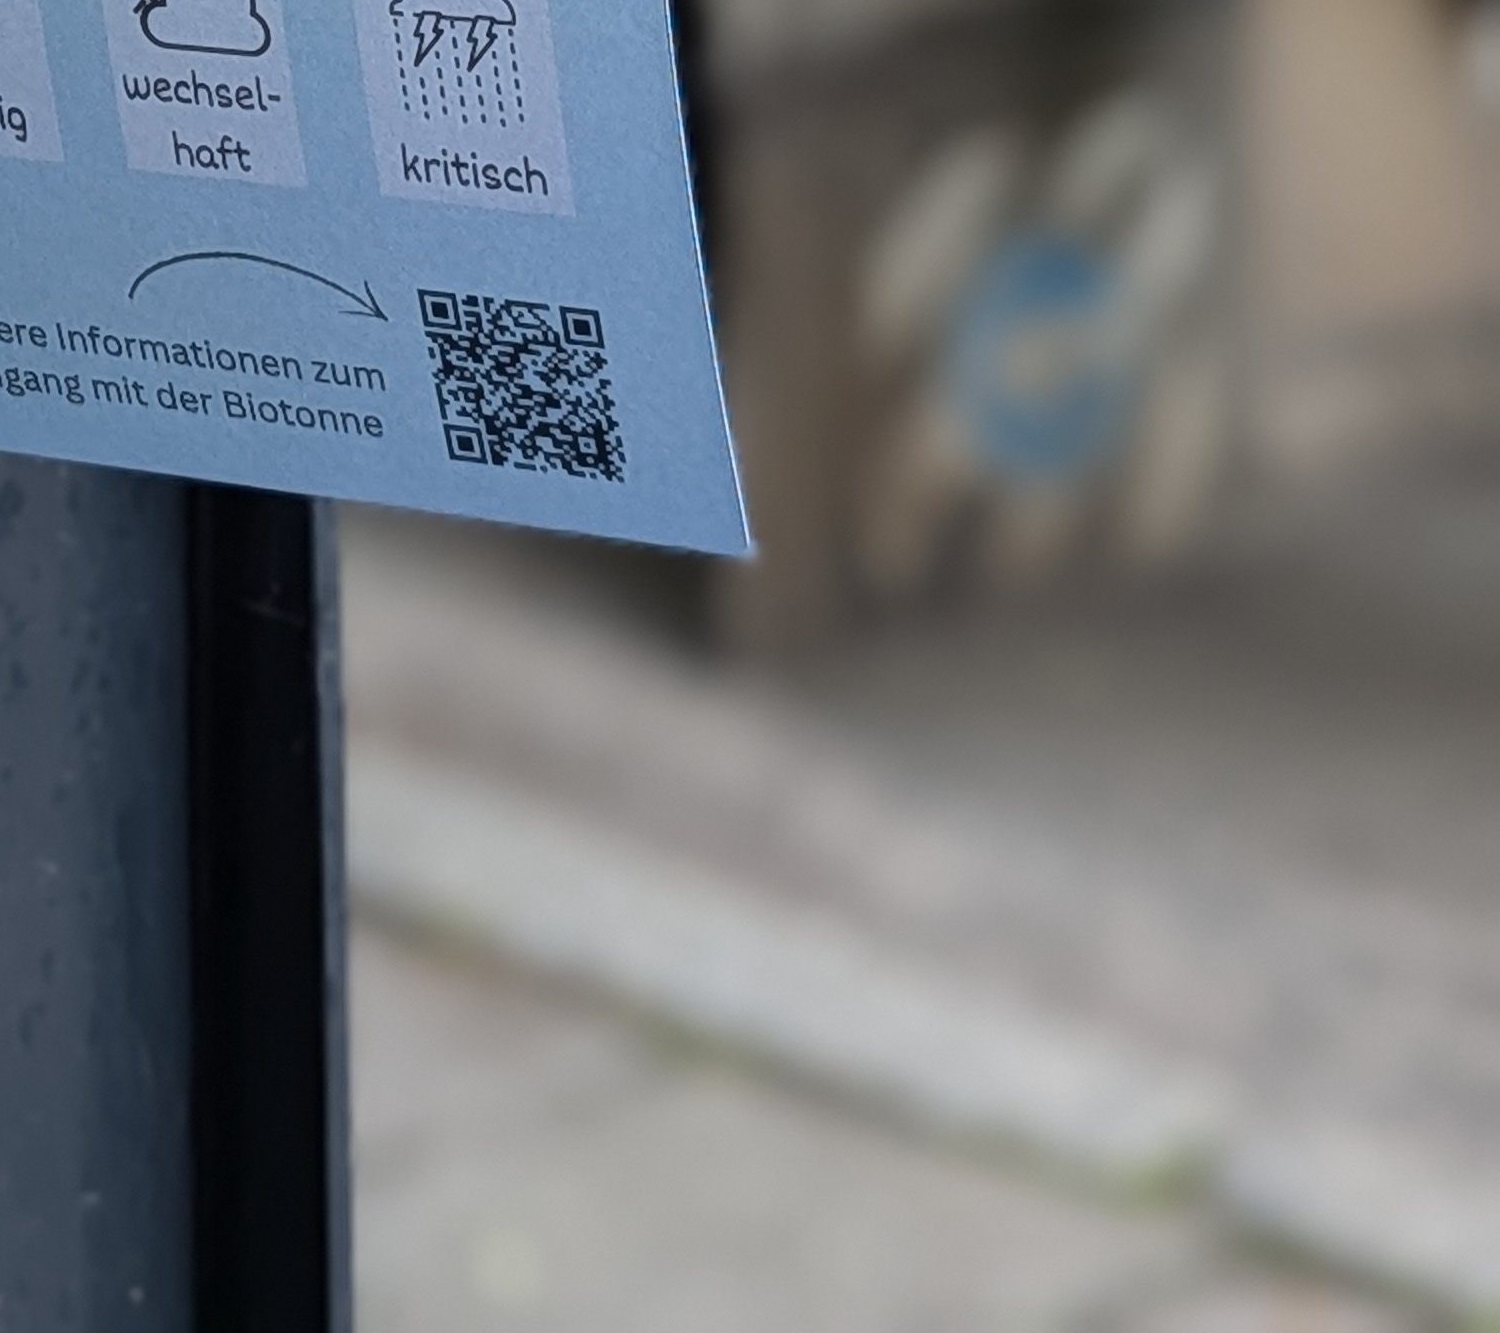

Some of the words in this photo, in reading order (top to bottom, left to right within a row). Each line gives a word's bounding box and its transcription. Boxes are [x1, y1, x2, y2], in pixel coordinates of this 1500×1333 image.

[122, 70, 281, 110] wechsel-
[173, 131, 252, 172] haft
[401, 144, 549, 196] kritisch
[56, 322, 303, 381] Informationen
[311, 356, 386, 392] zum
[92, 375, 150, 408] mit
[157, 381, 212, 416] der
[224, 389, 384, 438] Biotonne
